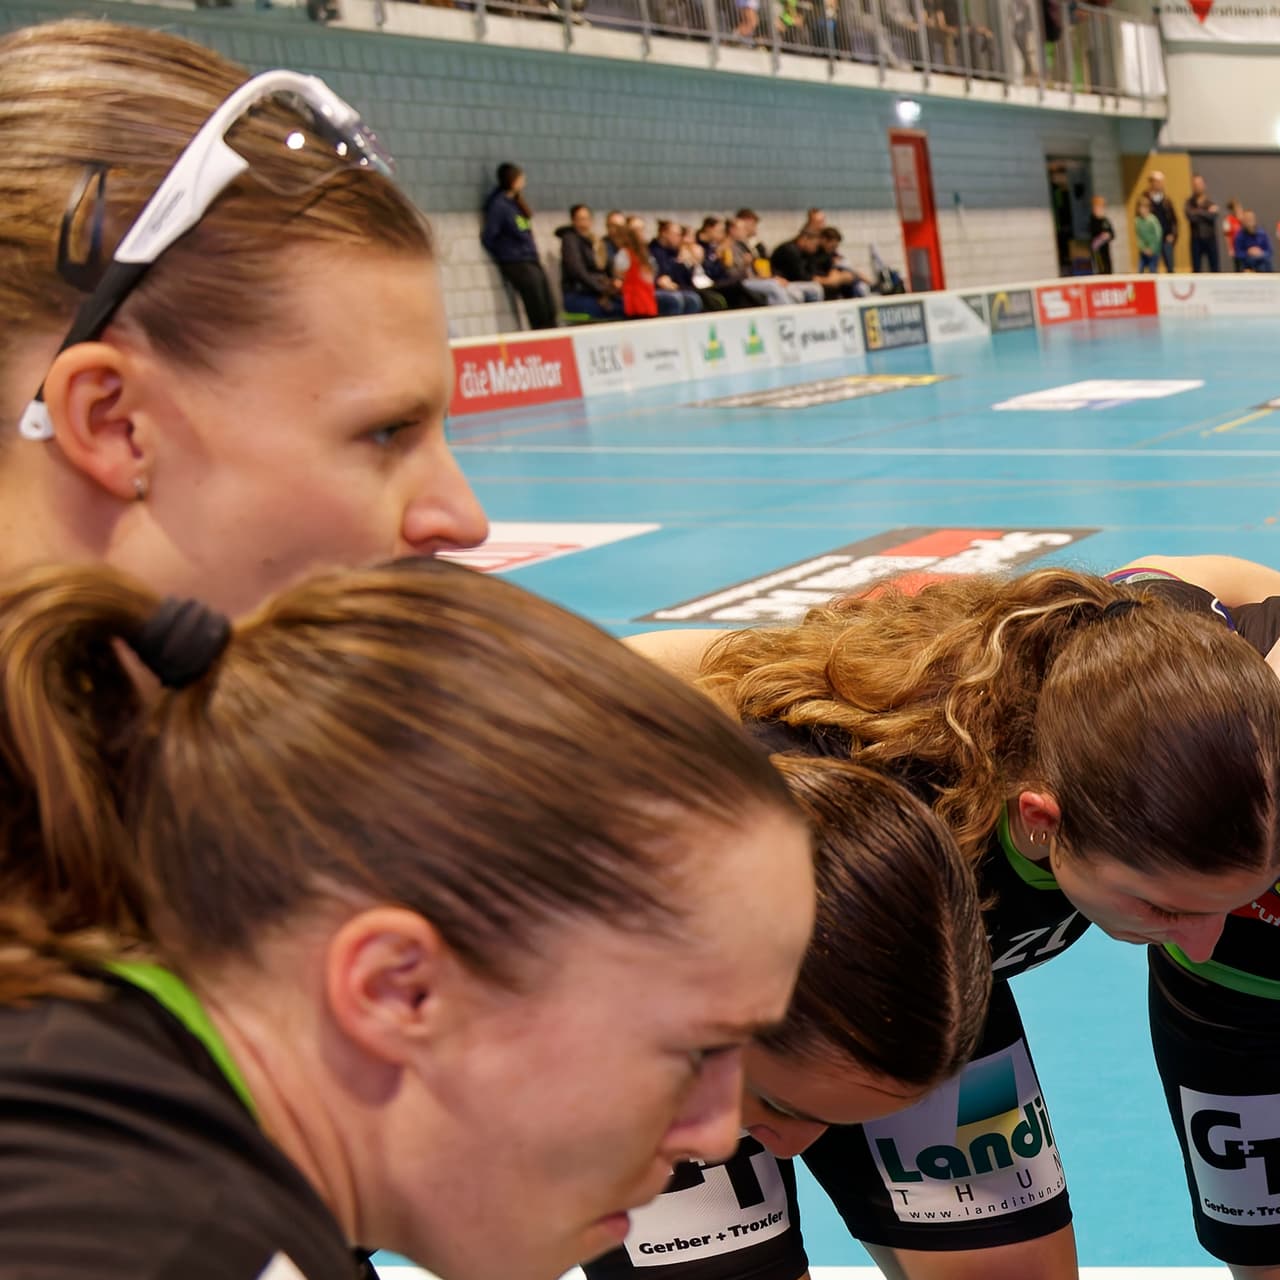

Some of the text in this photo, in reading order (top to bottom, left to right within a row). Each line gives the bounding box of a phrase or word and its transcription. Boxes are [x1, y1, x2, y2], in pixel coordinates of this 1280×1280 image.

[875, 1096, 1053, 1183] Landi
[1204, 1197, 1244, 1217] Gerber
[638, 1232, 712, 1257] Gerber
[728, 1208, 784, 1239] Troxler
